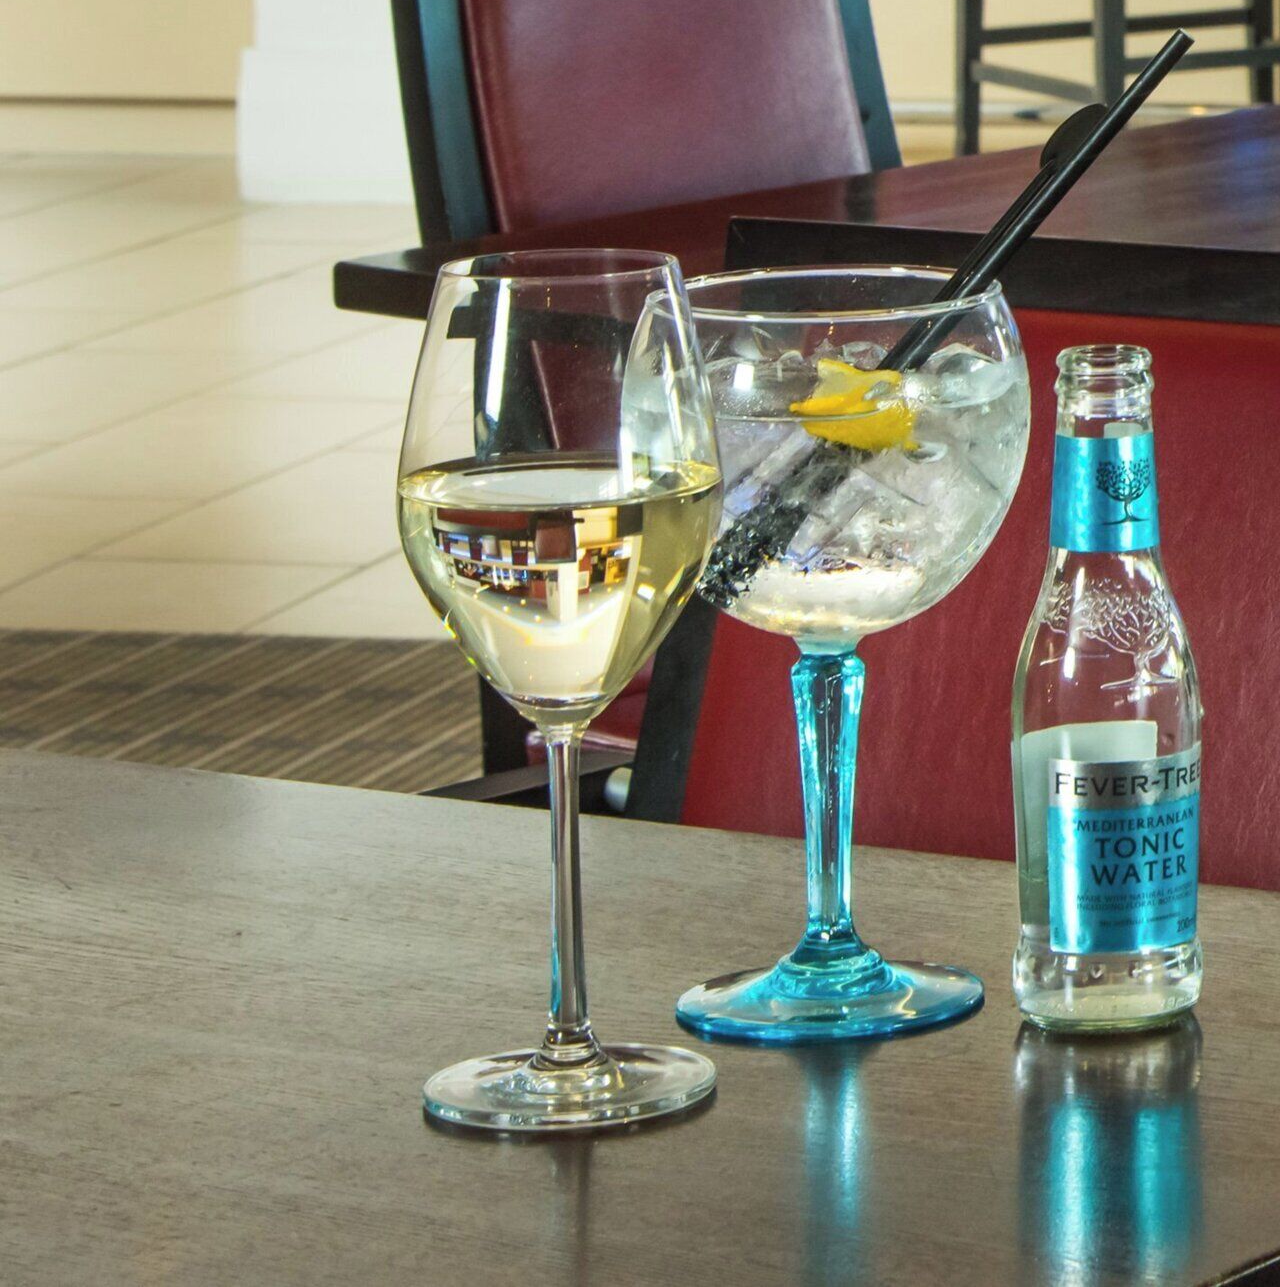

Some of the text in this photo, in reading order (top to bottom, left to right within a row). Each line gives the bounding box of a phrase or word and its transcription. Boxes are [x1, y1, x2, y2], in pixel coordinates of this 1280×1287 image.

[1076, 806, 1195, 832] MEDITERRANEAN
[1095, 828, 1185, 859] TONIC
[1091, 855, 1187, 886] WATER
